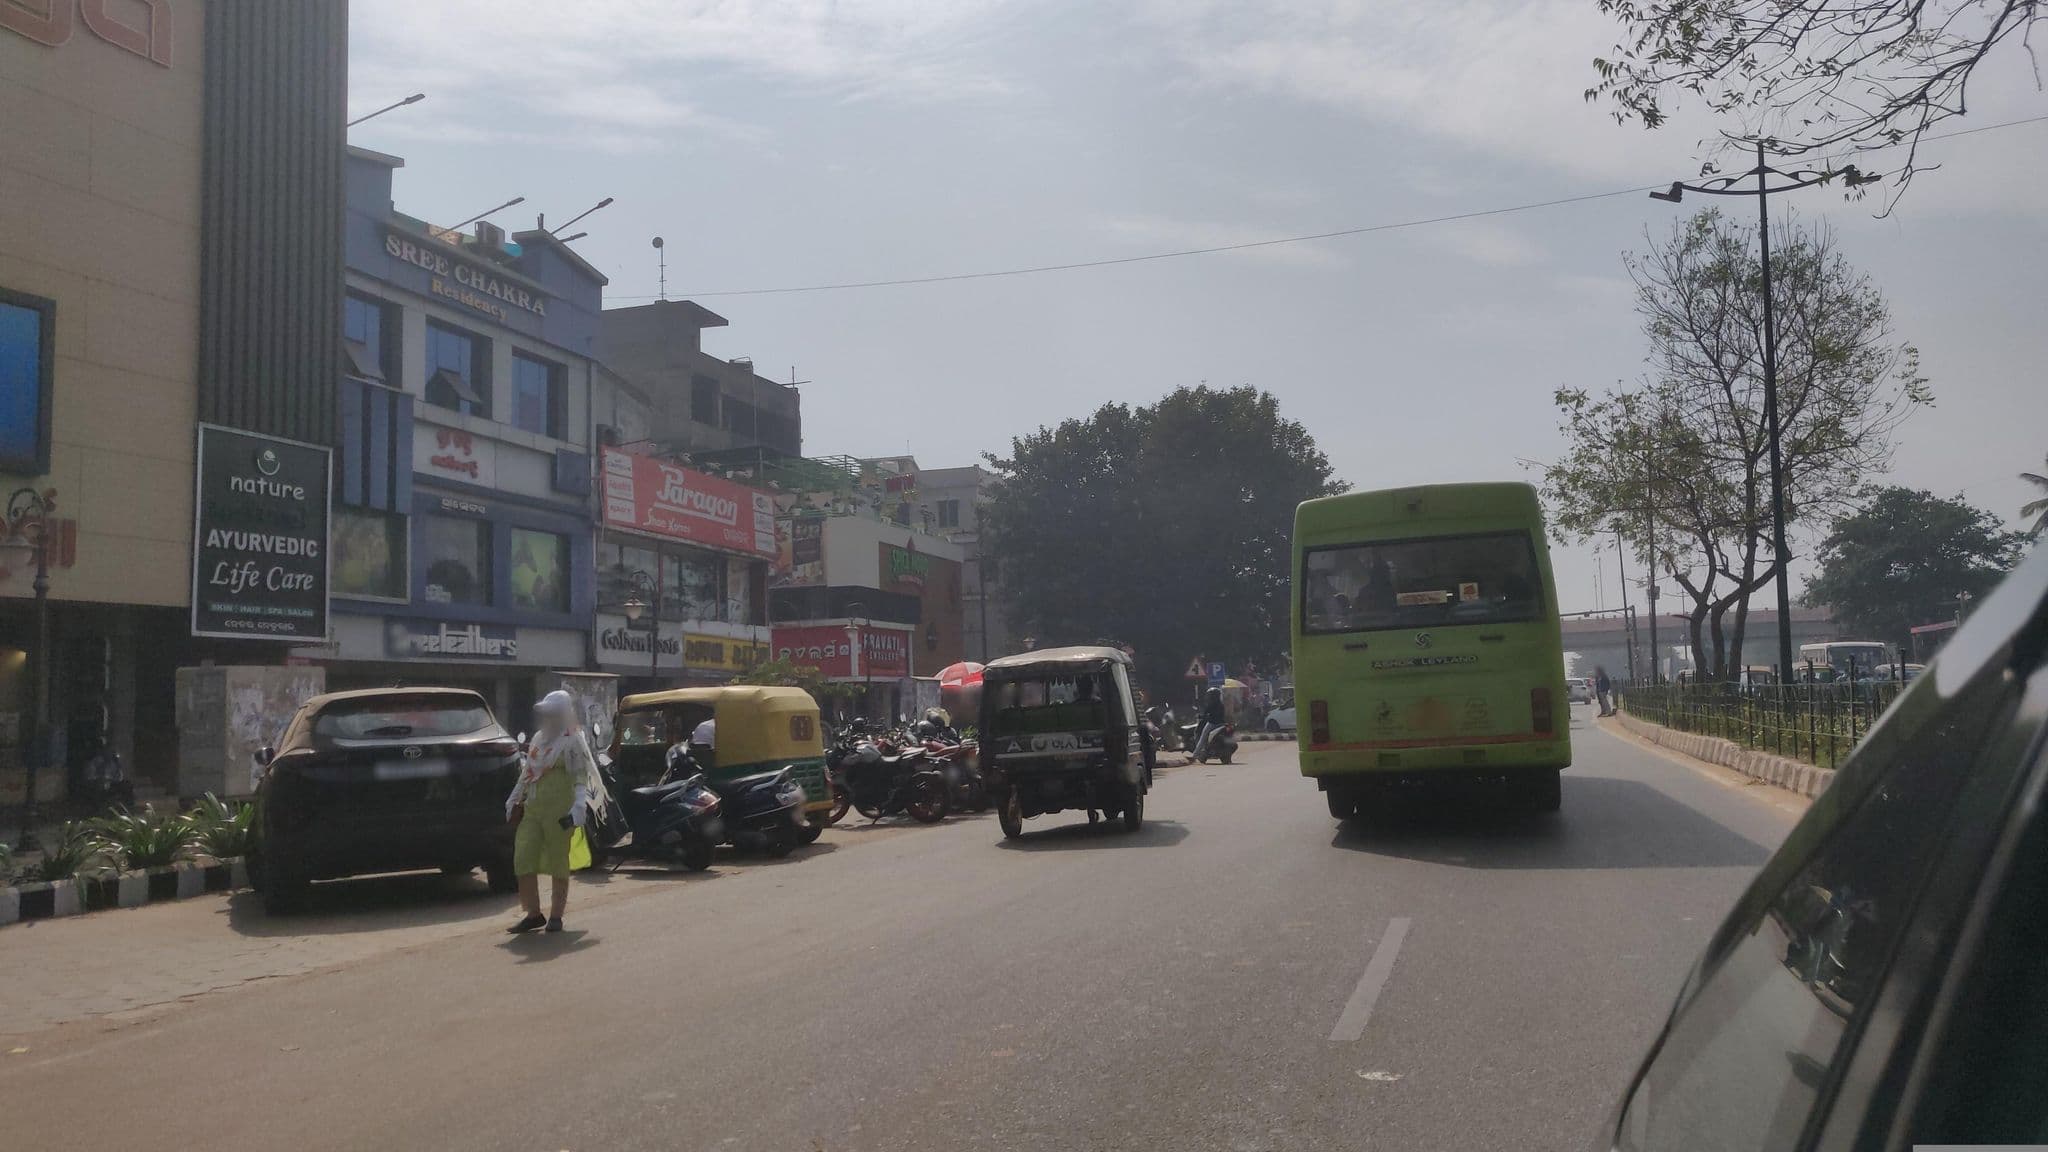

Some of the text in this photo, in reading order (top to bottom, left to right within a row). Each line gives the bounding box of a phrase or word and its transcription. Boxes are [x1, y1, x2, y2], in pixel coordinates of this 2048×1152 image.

[386, 234, 547, 317] SREE CHAKRA
[431, 277, 509, 322] Residency
[231, 476, 305, 500] nature
[656, 463, 738, 522] Paragon
[206, 528, 318, 557] AYURVEDIC
[210, 561, 314, 593] Life Care
[1212, 664, 1222, 677] P
[1372, 655, 1479, 670] ASHOK LEYLAND
